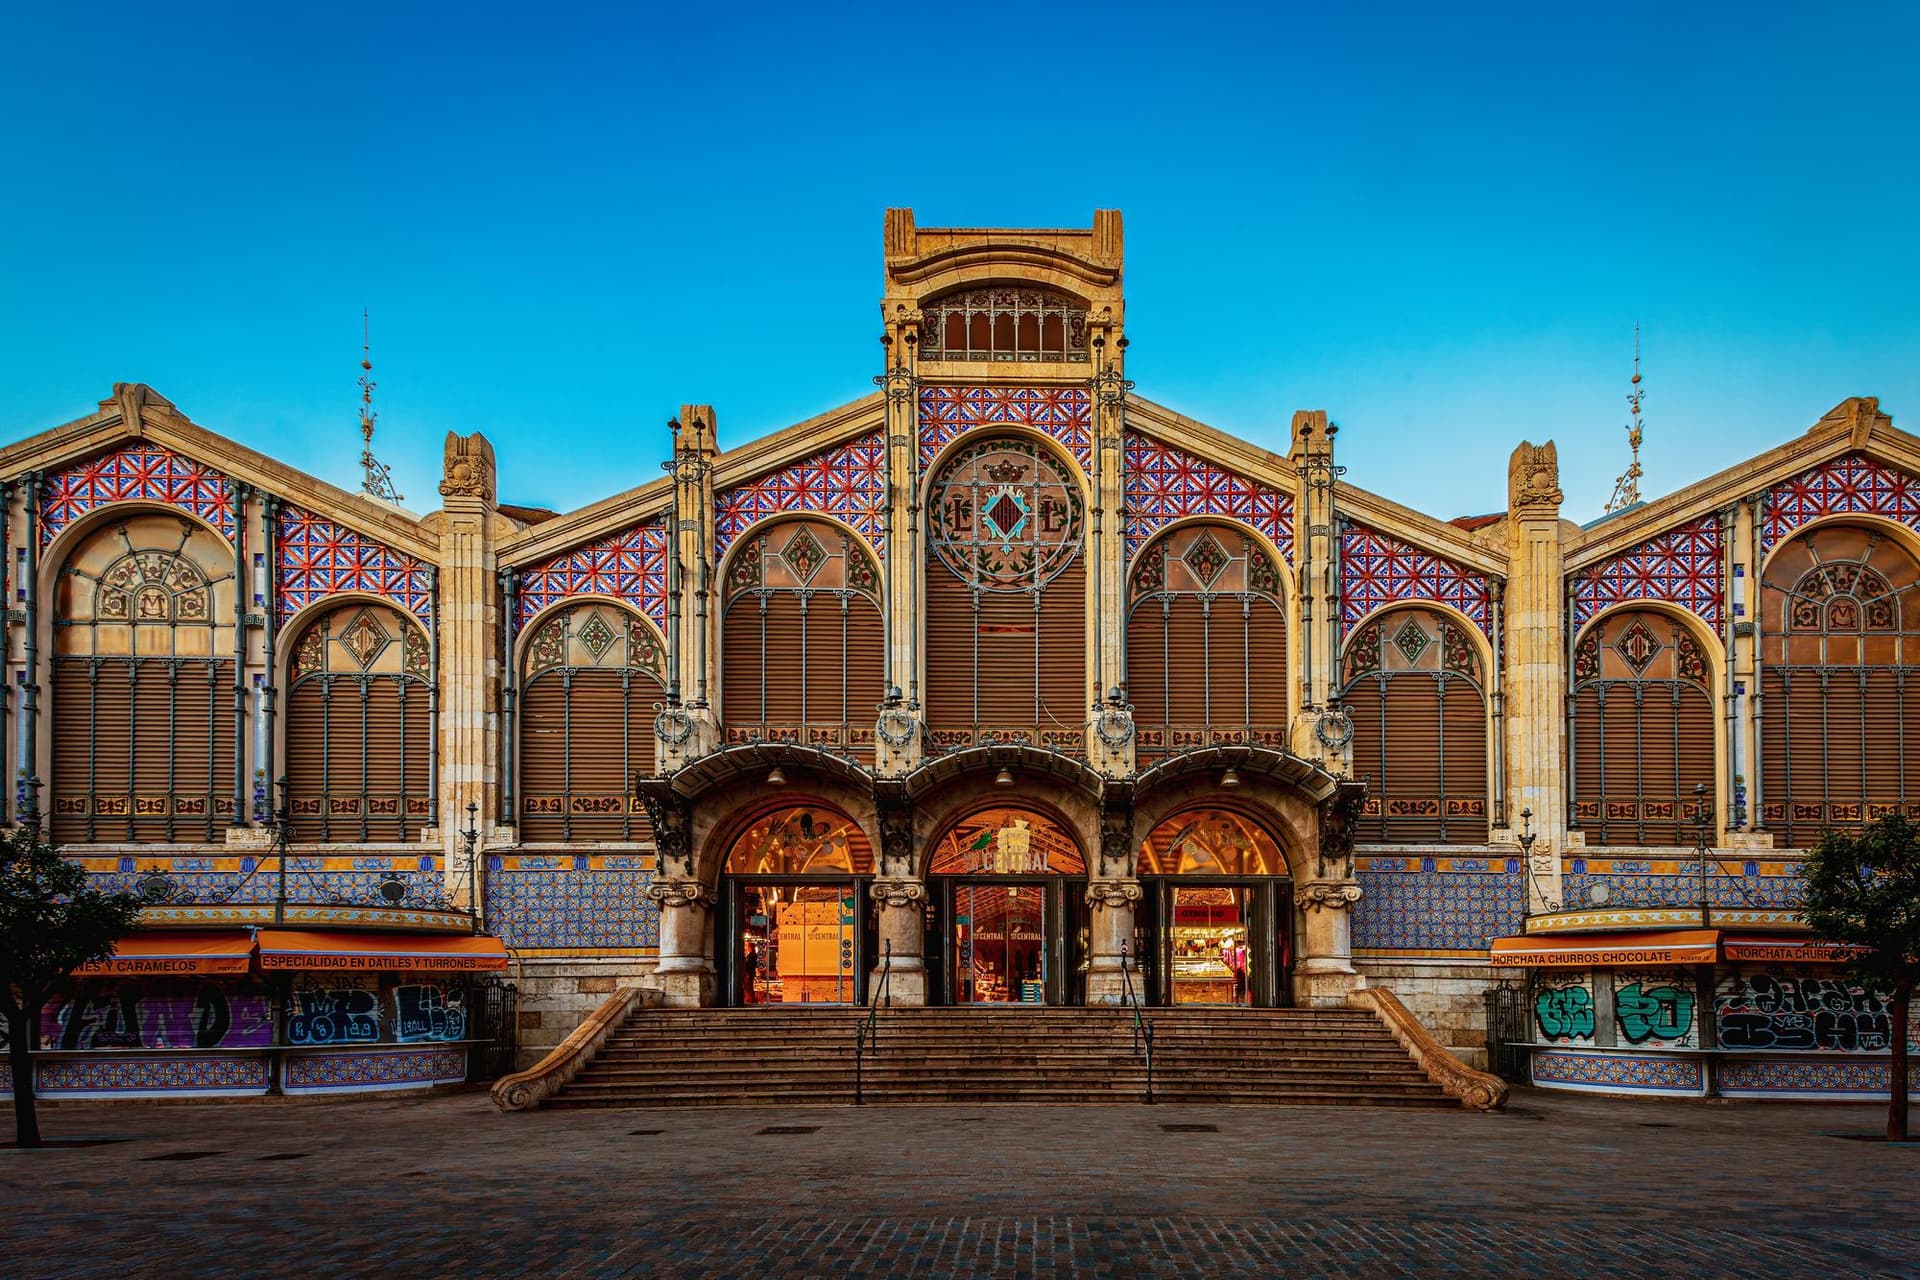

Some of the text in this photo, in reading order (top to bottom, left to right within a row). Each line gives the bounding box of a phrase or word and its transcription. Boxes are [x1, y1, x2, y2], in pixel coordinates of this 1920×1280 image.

[980, 932, 1003, 941] CENTRAL
[1017, 932, 1041, 941] CENTRAL
[1492, 951, 1673, 965] HORCHATA CHURROS CHOCOLATE
[1736, 948, 1792, 959] HORCHATA
[1795, 948, 1847, 959] CHURRS
[104, 961, 113, 972] Y
[117, 960, 197, 972] CARAMELOS
[262, 956, 476, 969] ESPECIALIDAD EN DATILES Y TURRONES
